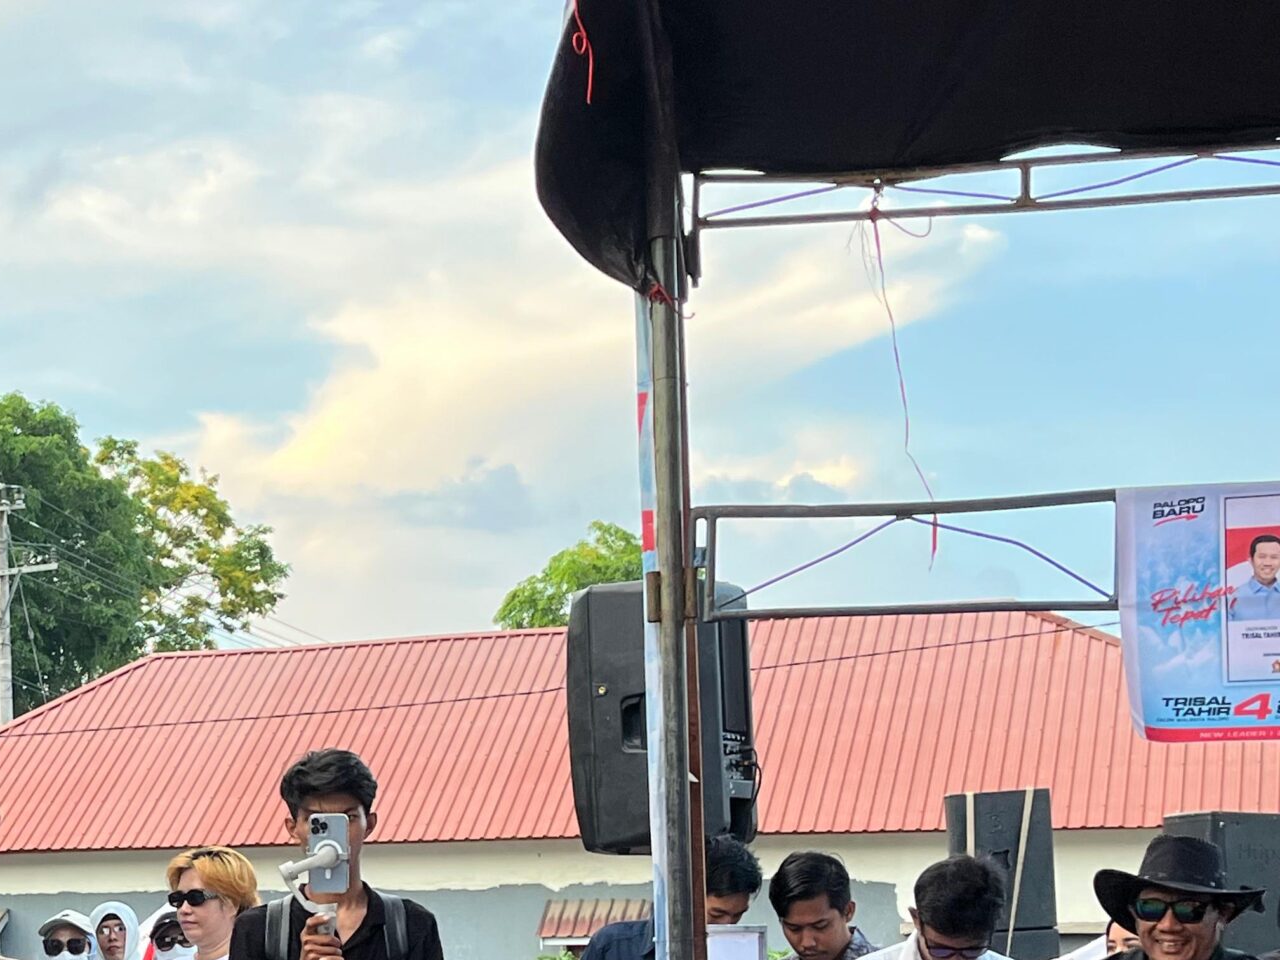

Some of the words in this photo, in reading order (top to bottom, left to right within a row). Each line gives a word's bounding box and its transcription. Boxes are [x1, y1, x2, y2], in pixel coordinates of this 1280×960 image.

[1153, 496, 1206, 509] PALOPO
[1152, 503, 1205, 520] BARU
[1151, 583, 1237, 612] Pilihan
[1162, 696, 1232, 708] TRISAL
[1233, 693, 1273, 720] 4
[1172, 706, 1231, 717] TAHIR
[1200, 731, 1225, 739] NEW
[1227, 730, 1268, 738] LEADER
